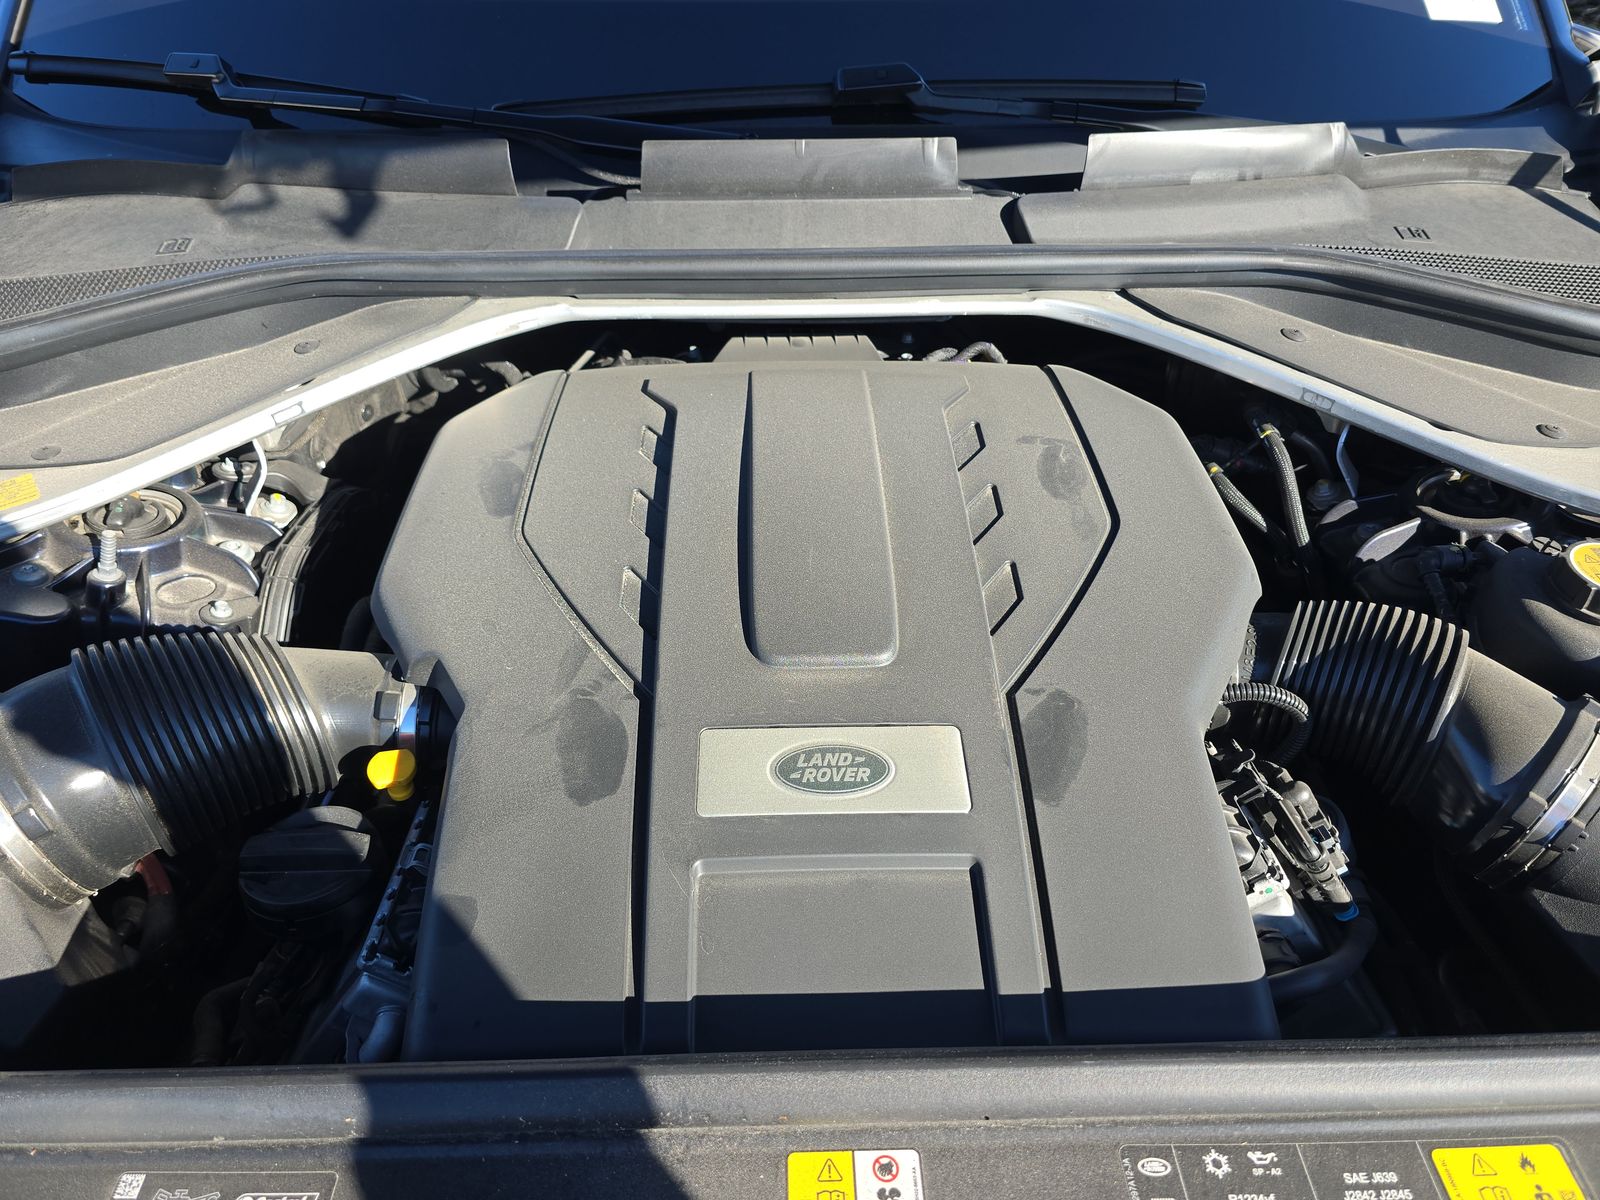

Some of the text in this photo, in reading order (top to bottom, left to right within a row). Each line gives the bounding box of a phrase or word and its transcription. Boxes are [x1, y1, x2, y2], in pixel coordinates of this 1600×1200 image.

[796, 752, 852, 767] LAND
[801, 766, 871, 783] ROVER
[1343, 1171, 1398, 1184] SAE J639
[1344, 1188, 1413, 1200] J2842 J2845
